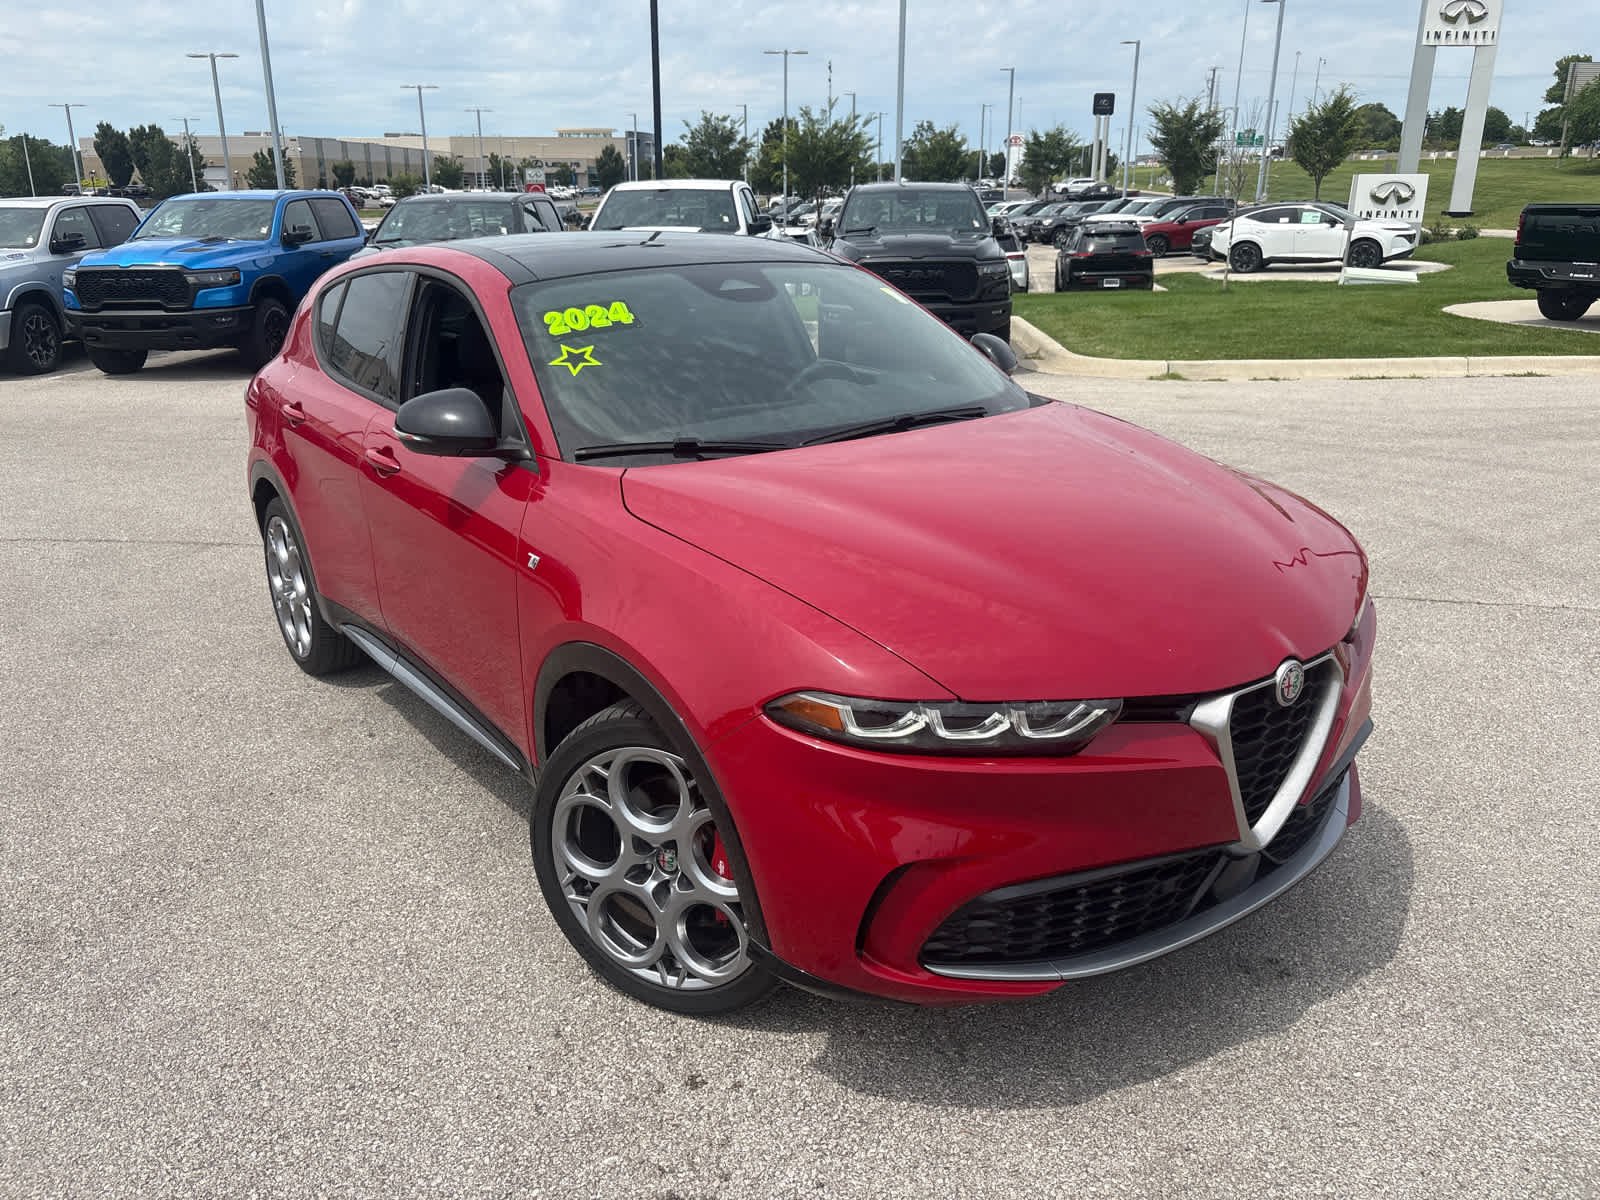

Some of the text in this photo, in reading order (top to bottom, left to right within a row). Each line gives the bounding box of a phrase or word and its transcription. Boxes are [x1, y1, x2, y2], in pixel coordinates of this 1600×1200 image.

[1426, 30, 1496, 40] INFINITI
[1359, 210, 1419, 218] INFINITI
[543, 301, 635, 335] 2024
